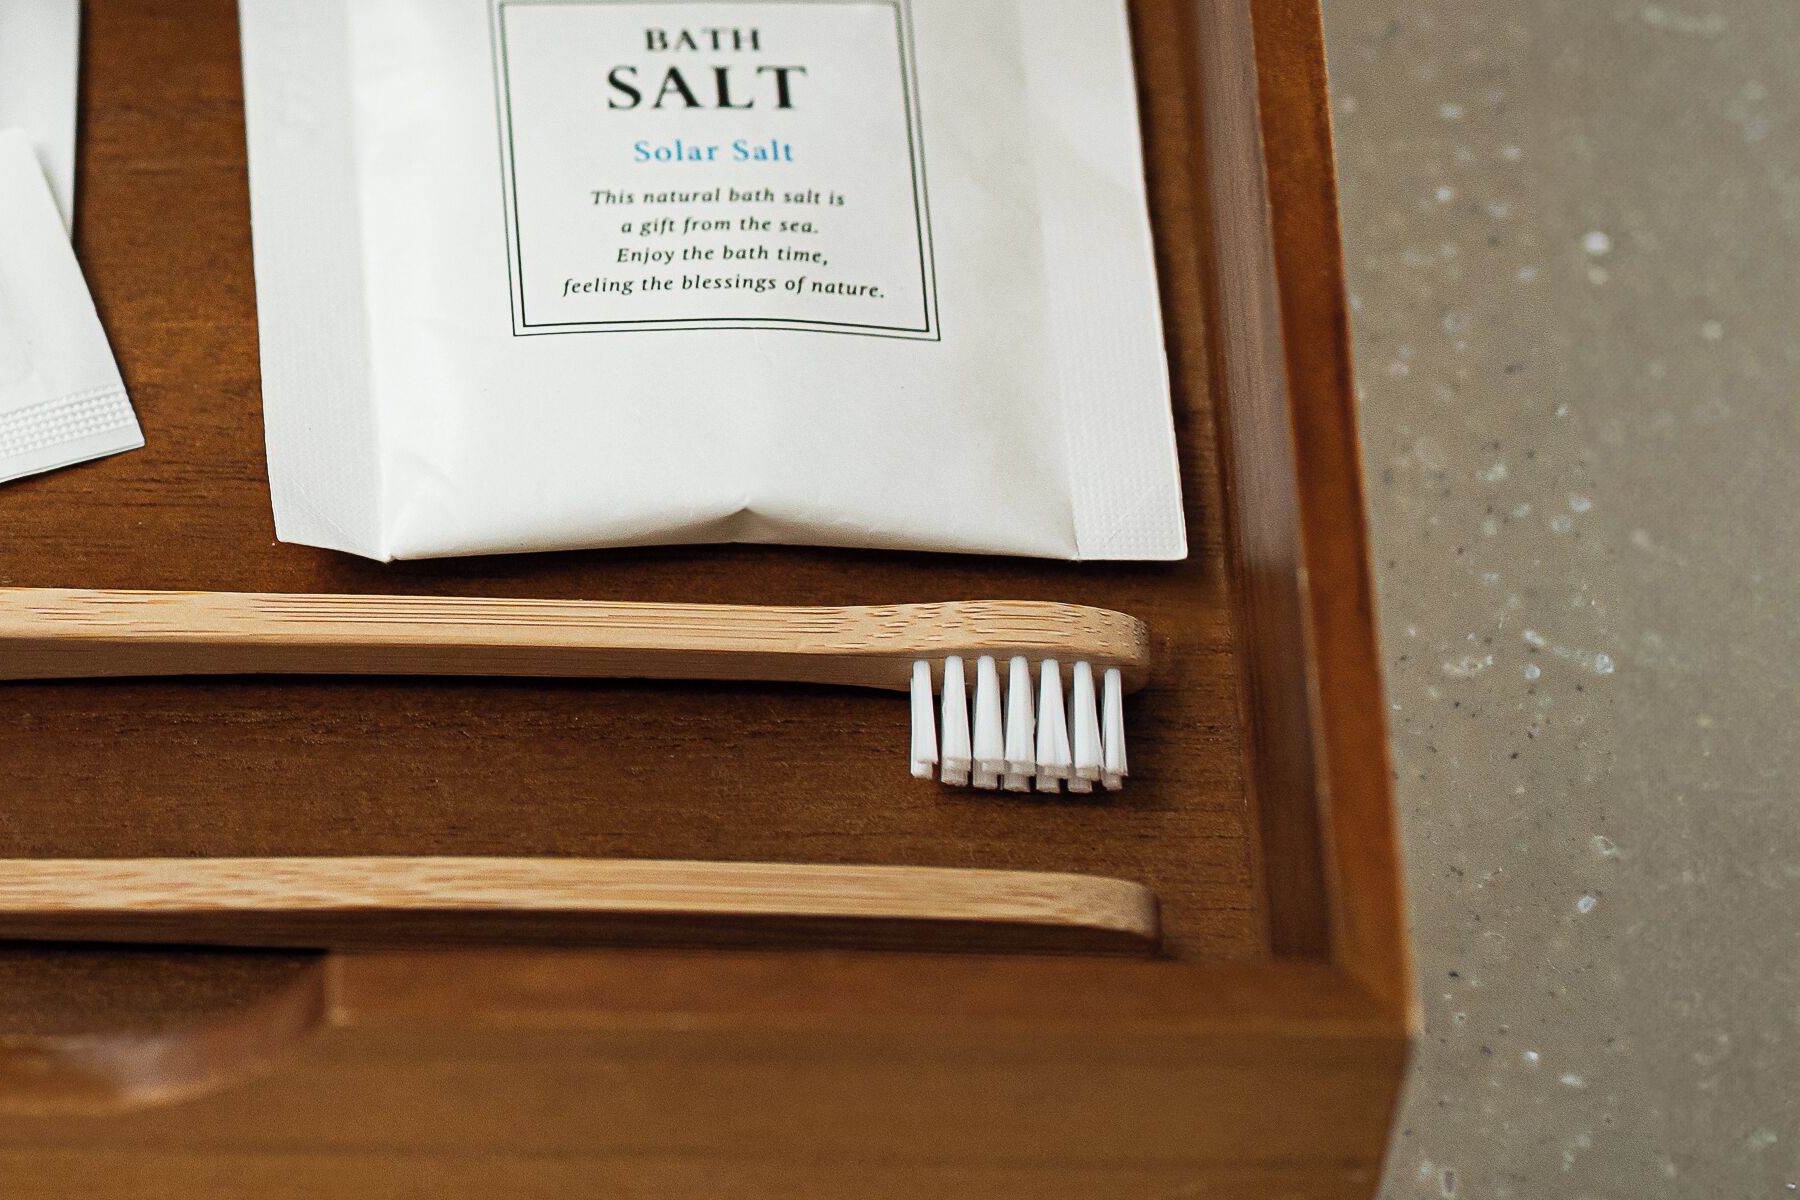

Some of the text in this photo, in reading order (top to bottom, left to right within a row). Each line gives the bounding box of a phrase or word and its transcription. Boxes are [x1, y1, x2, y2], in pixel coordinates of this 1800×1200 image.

[645, 28, 761, 52] BATH
[607, 66, 806, 110] SALT
[633, 138, 793, 162] Solar Salt
[591, 187, 845, 207] This natural bath salt is
[620, 215, 818, 237] a gift from the sea.
[616, 244, 829, 267] Enjoy the bath time,
[562, 274, 885, 299] feeling the blessings of nature.
